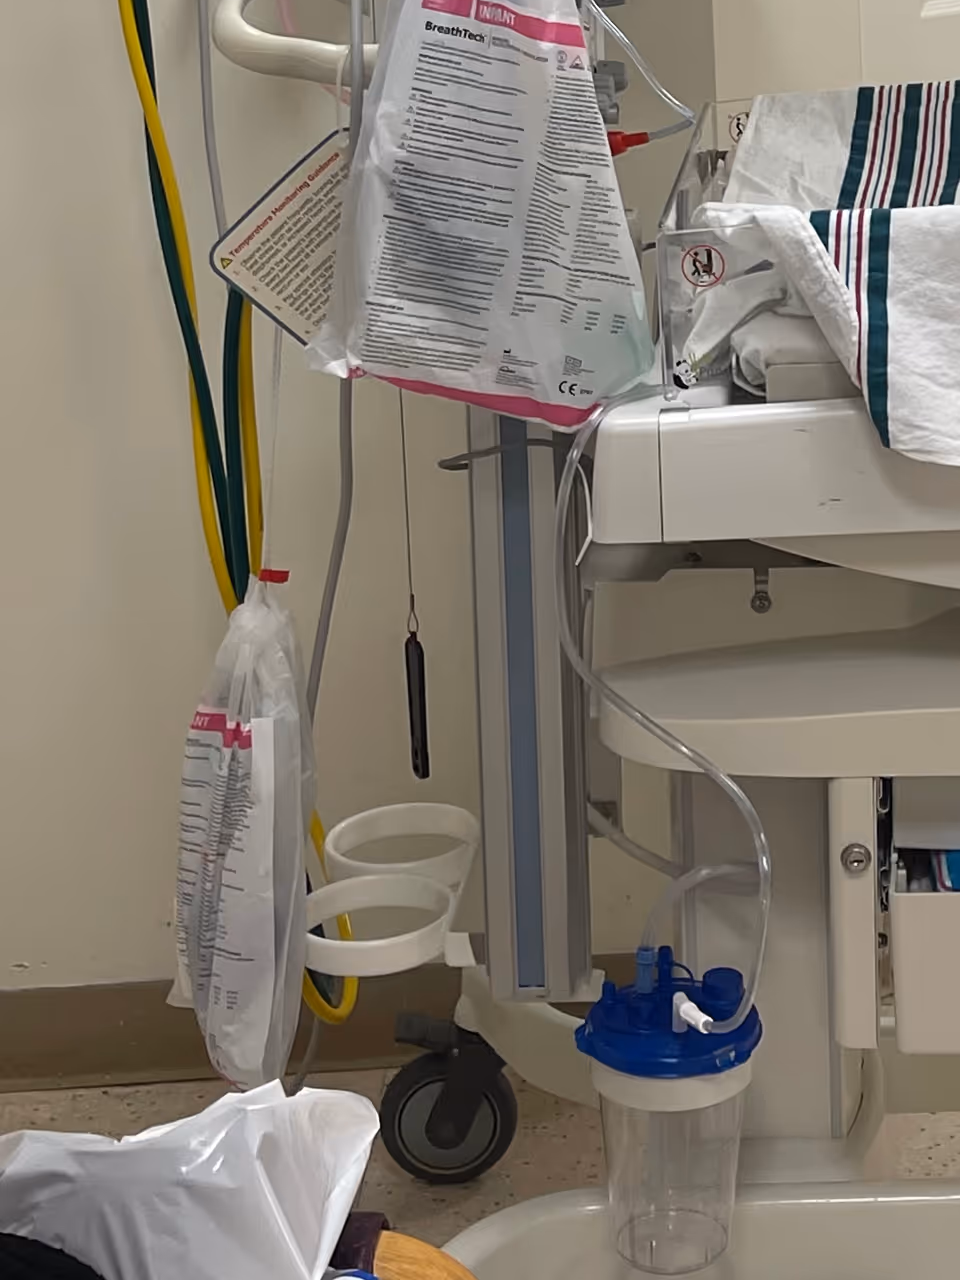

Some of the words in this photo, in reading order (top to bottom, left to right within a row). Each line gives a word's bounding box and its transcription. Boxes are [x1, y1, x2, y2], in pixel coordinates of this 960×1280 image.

[424, 21, 485, 44] BreathTech
[229, 215, 274, 257] Temperature
[271, 180, 310, 217] Monitoring
[307, 151, 340, 182] Guidance
